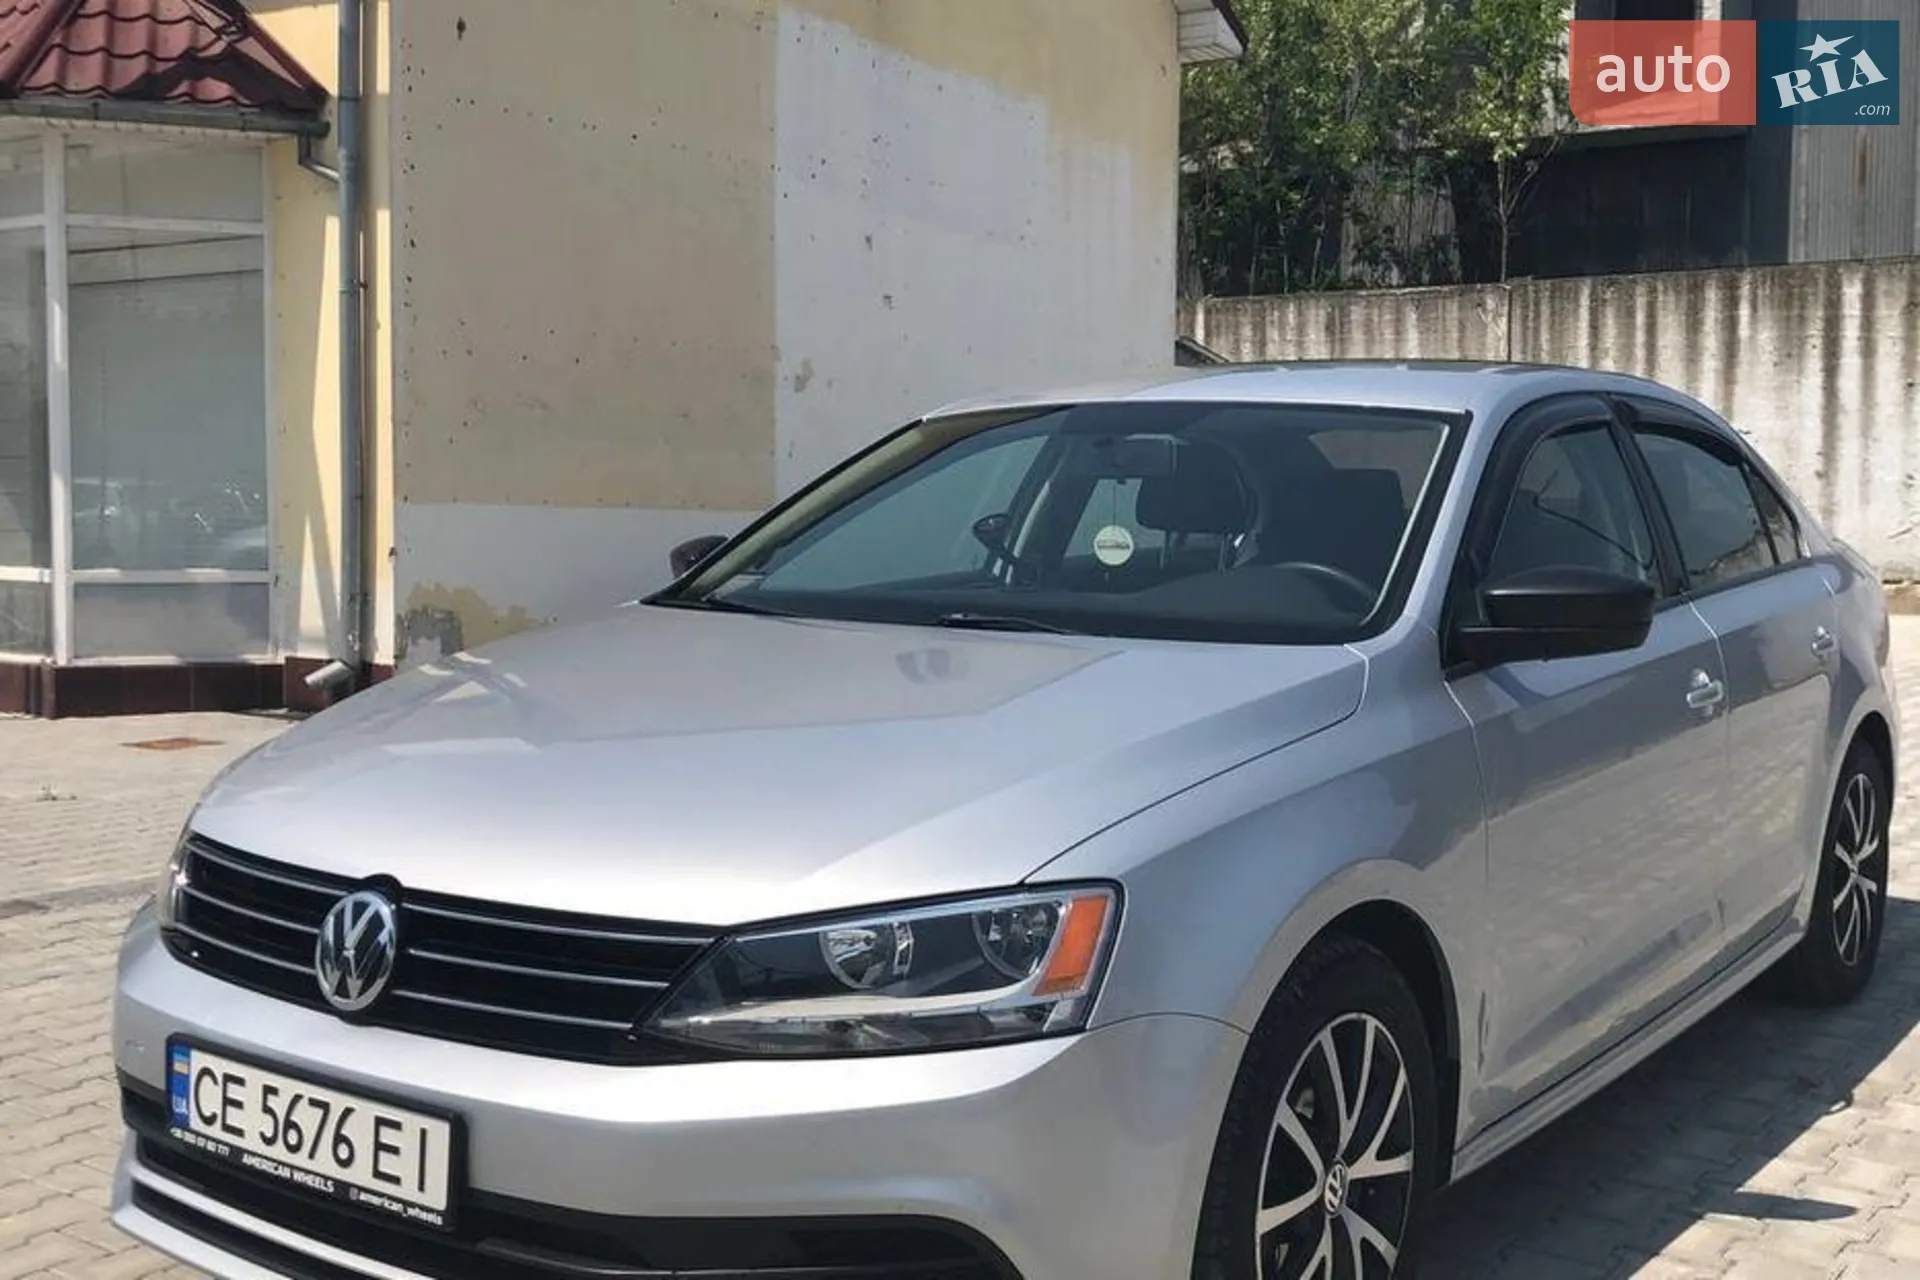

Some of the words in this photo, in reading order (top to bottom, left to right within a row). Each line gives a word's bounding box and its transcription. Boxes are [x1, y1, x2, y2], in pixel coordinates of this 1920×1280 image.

[193, 1066, 246, 1138] CE
[259, 1085, 356, 1169] 5676
[372, 1115, 427, 1193] EI
[242, 1153, 291, 1178] AMERICAN
[292, 1168, 335, 1193] WHEELS
